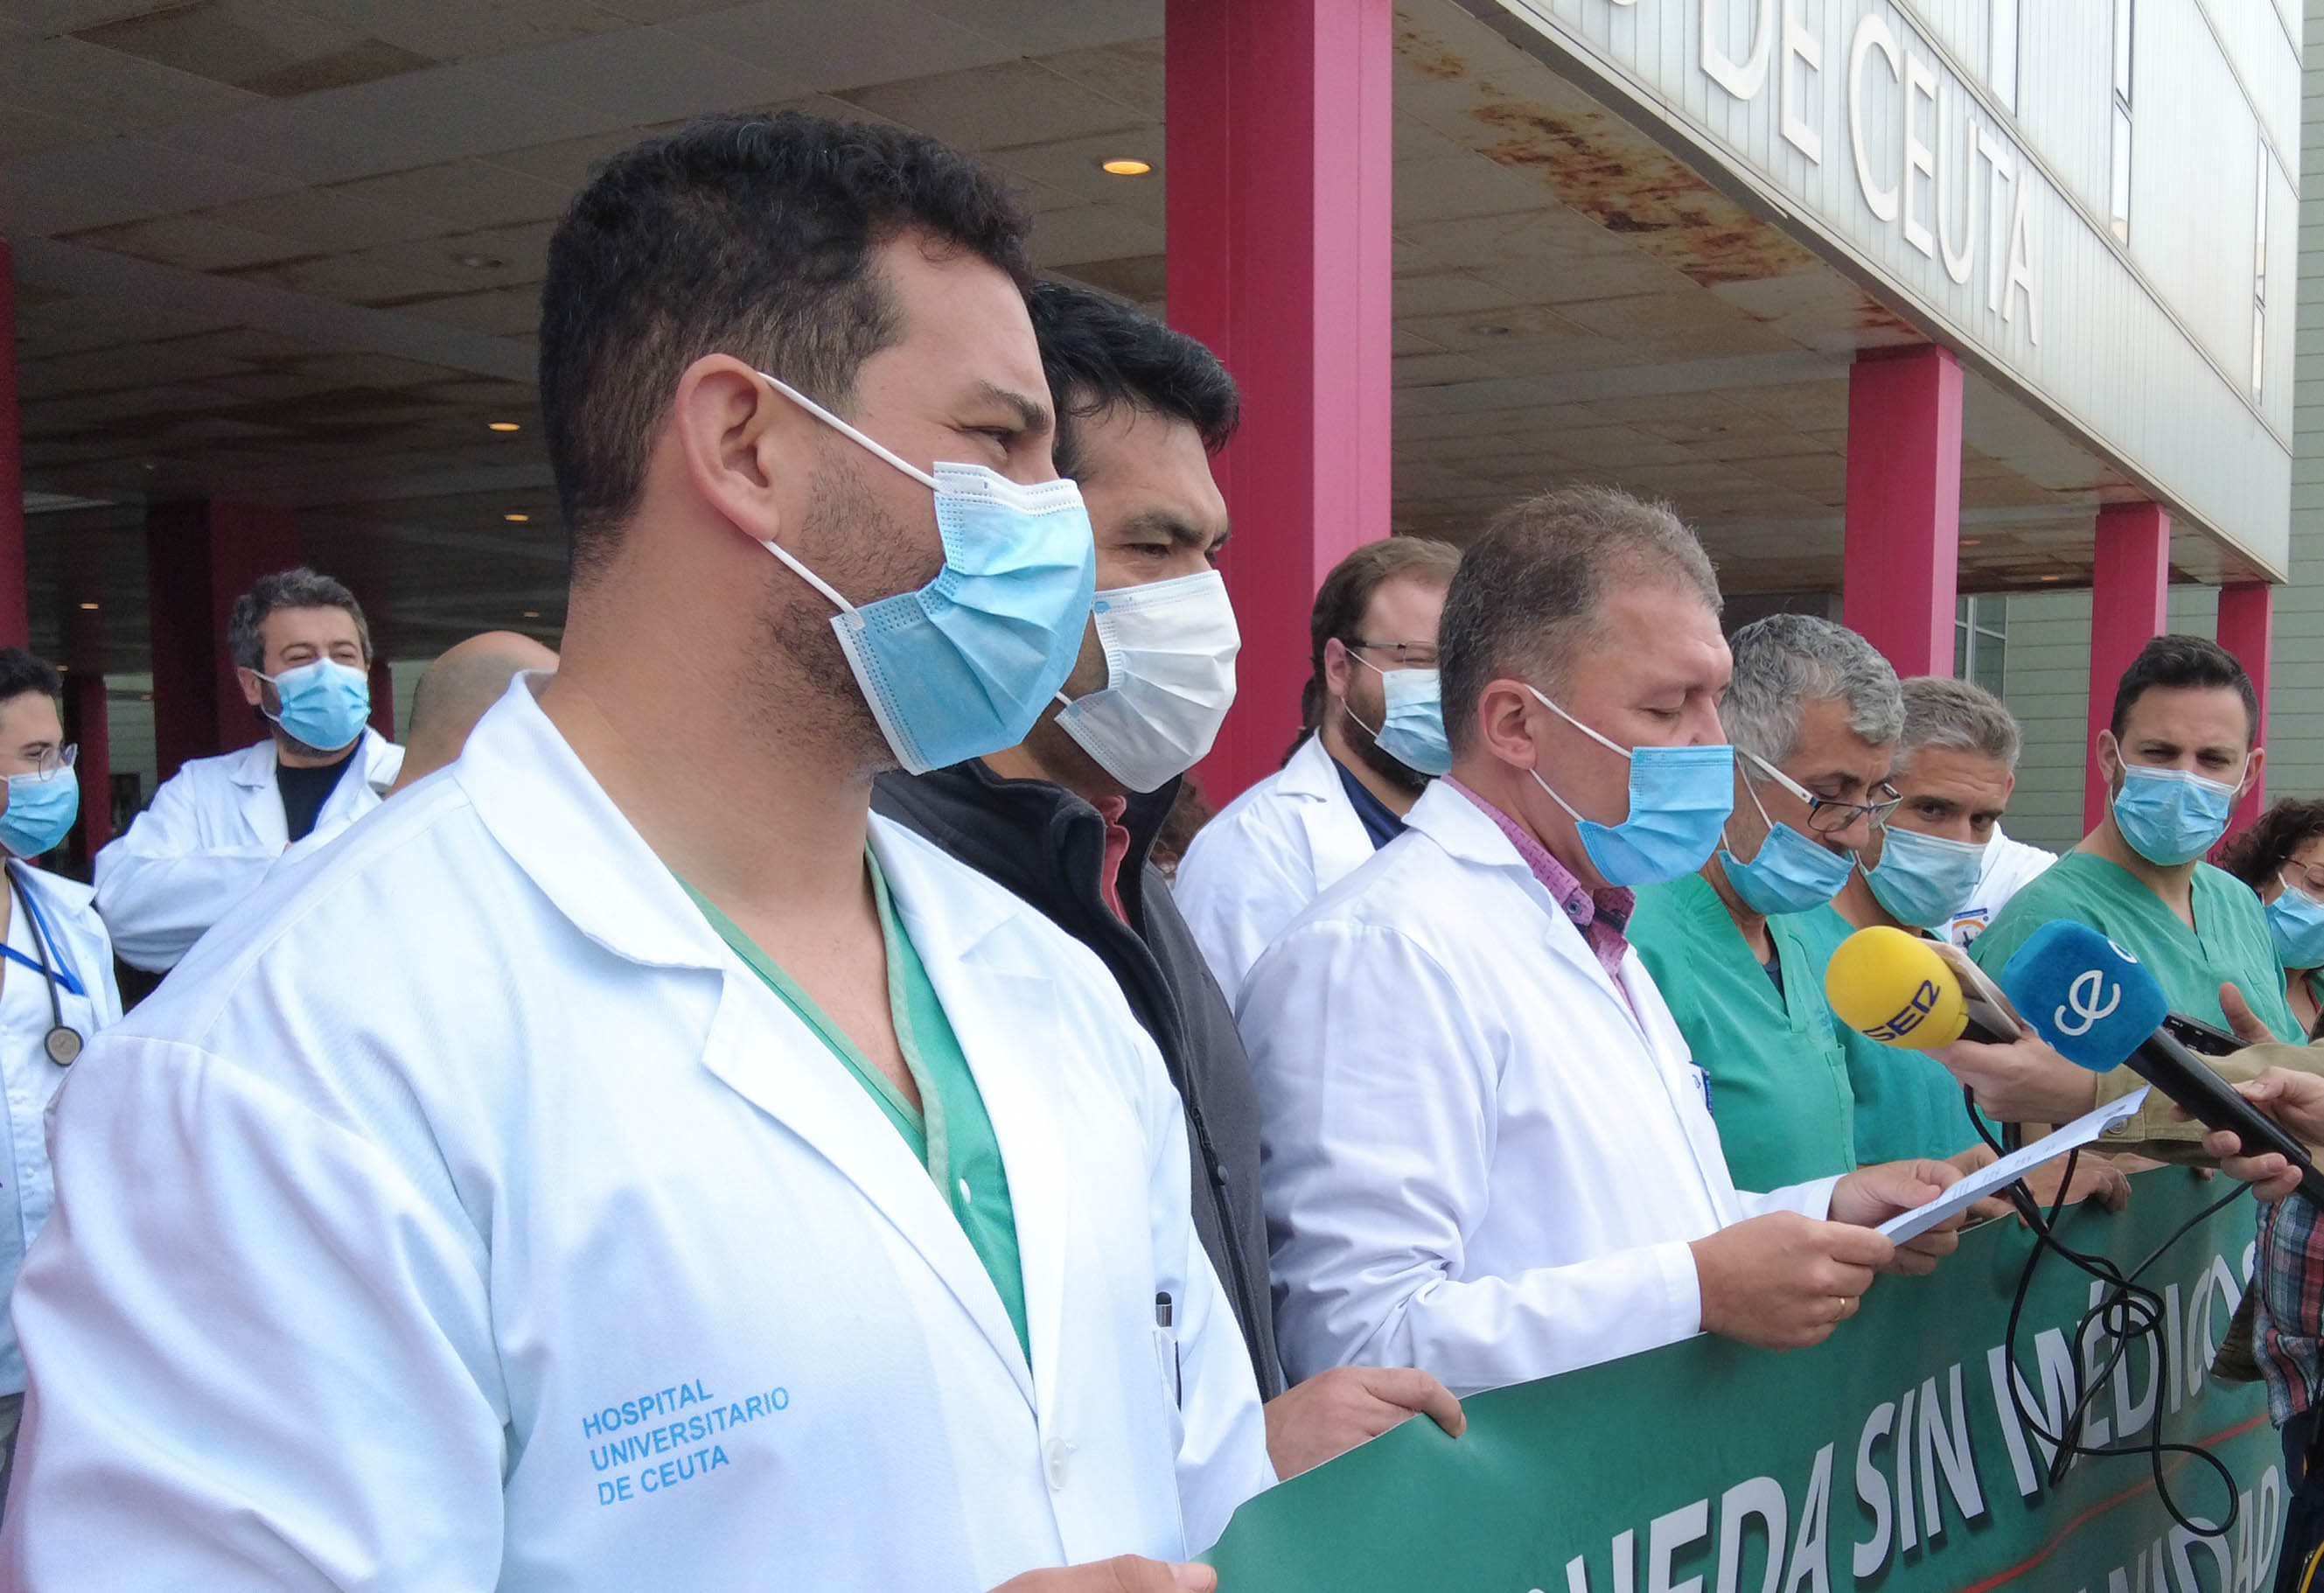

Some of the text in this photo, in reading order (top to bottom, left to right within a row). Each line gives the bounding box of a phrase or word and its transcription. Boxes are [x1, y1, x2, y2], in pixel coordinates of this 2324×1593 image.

[1848, 13, 2037, 346] CEUTA
[1861, 980, 1941, 1041] SER
[582, 1379, 714, 1439] HOSPITAL
[590, 1387, 789, 1471] UNIVERSITARIO
[1525, 1240, 2257, 1593] EDA SIN MÉDICO
[597, 1445, 730, 1506] DE CEUTA
